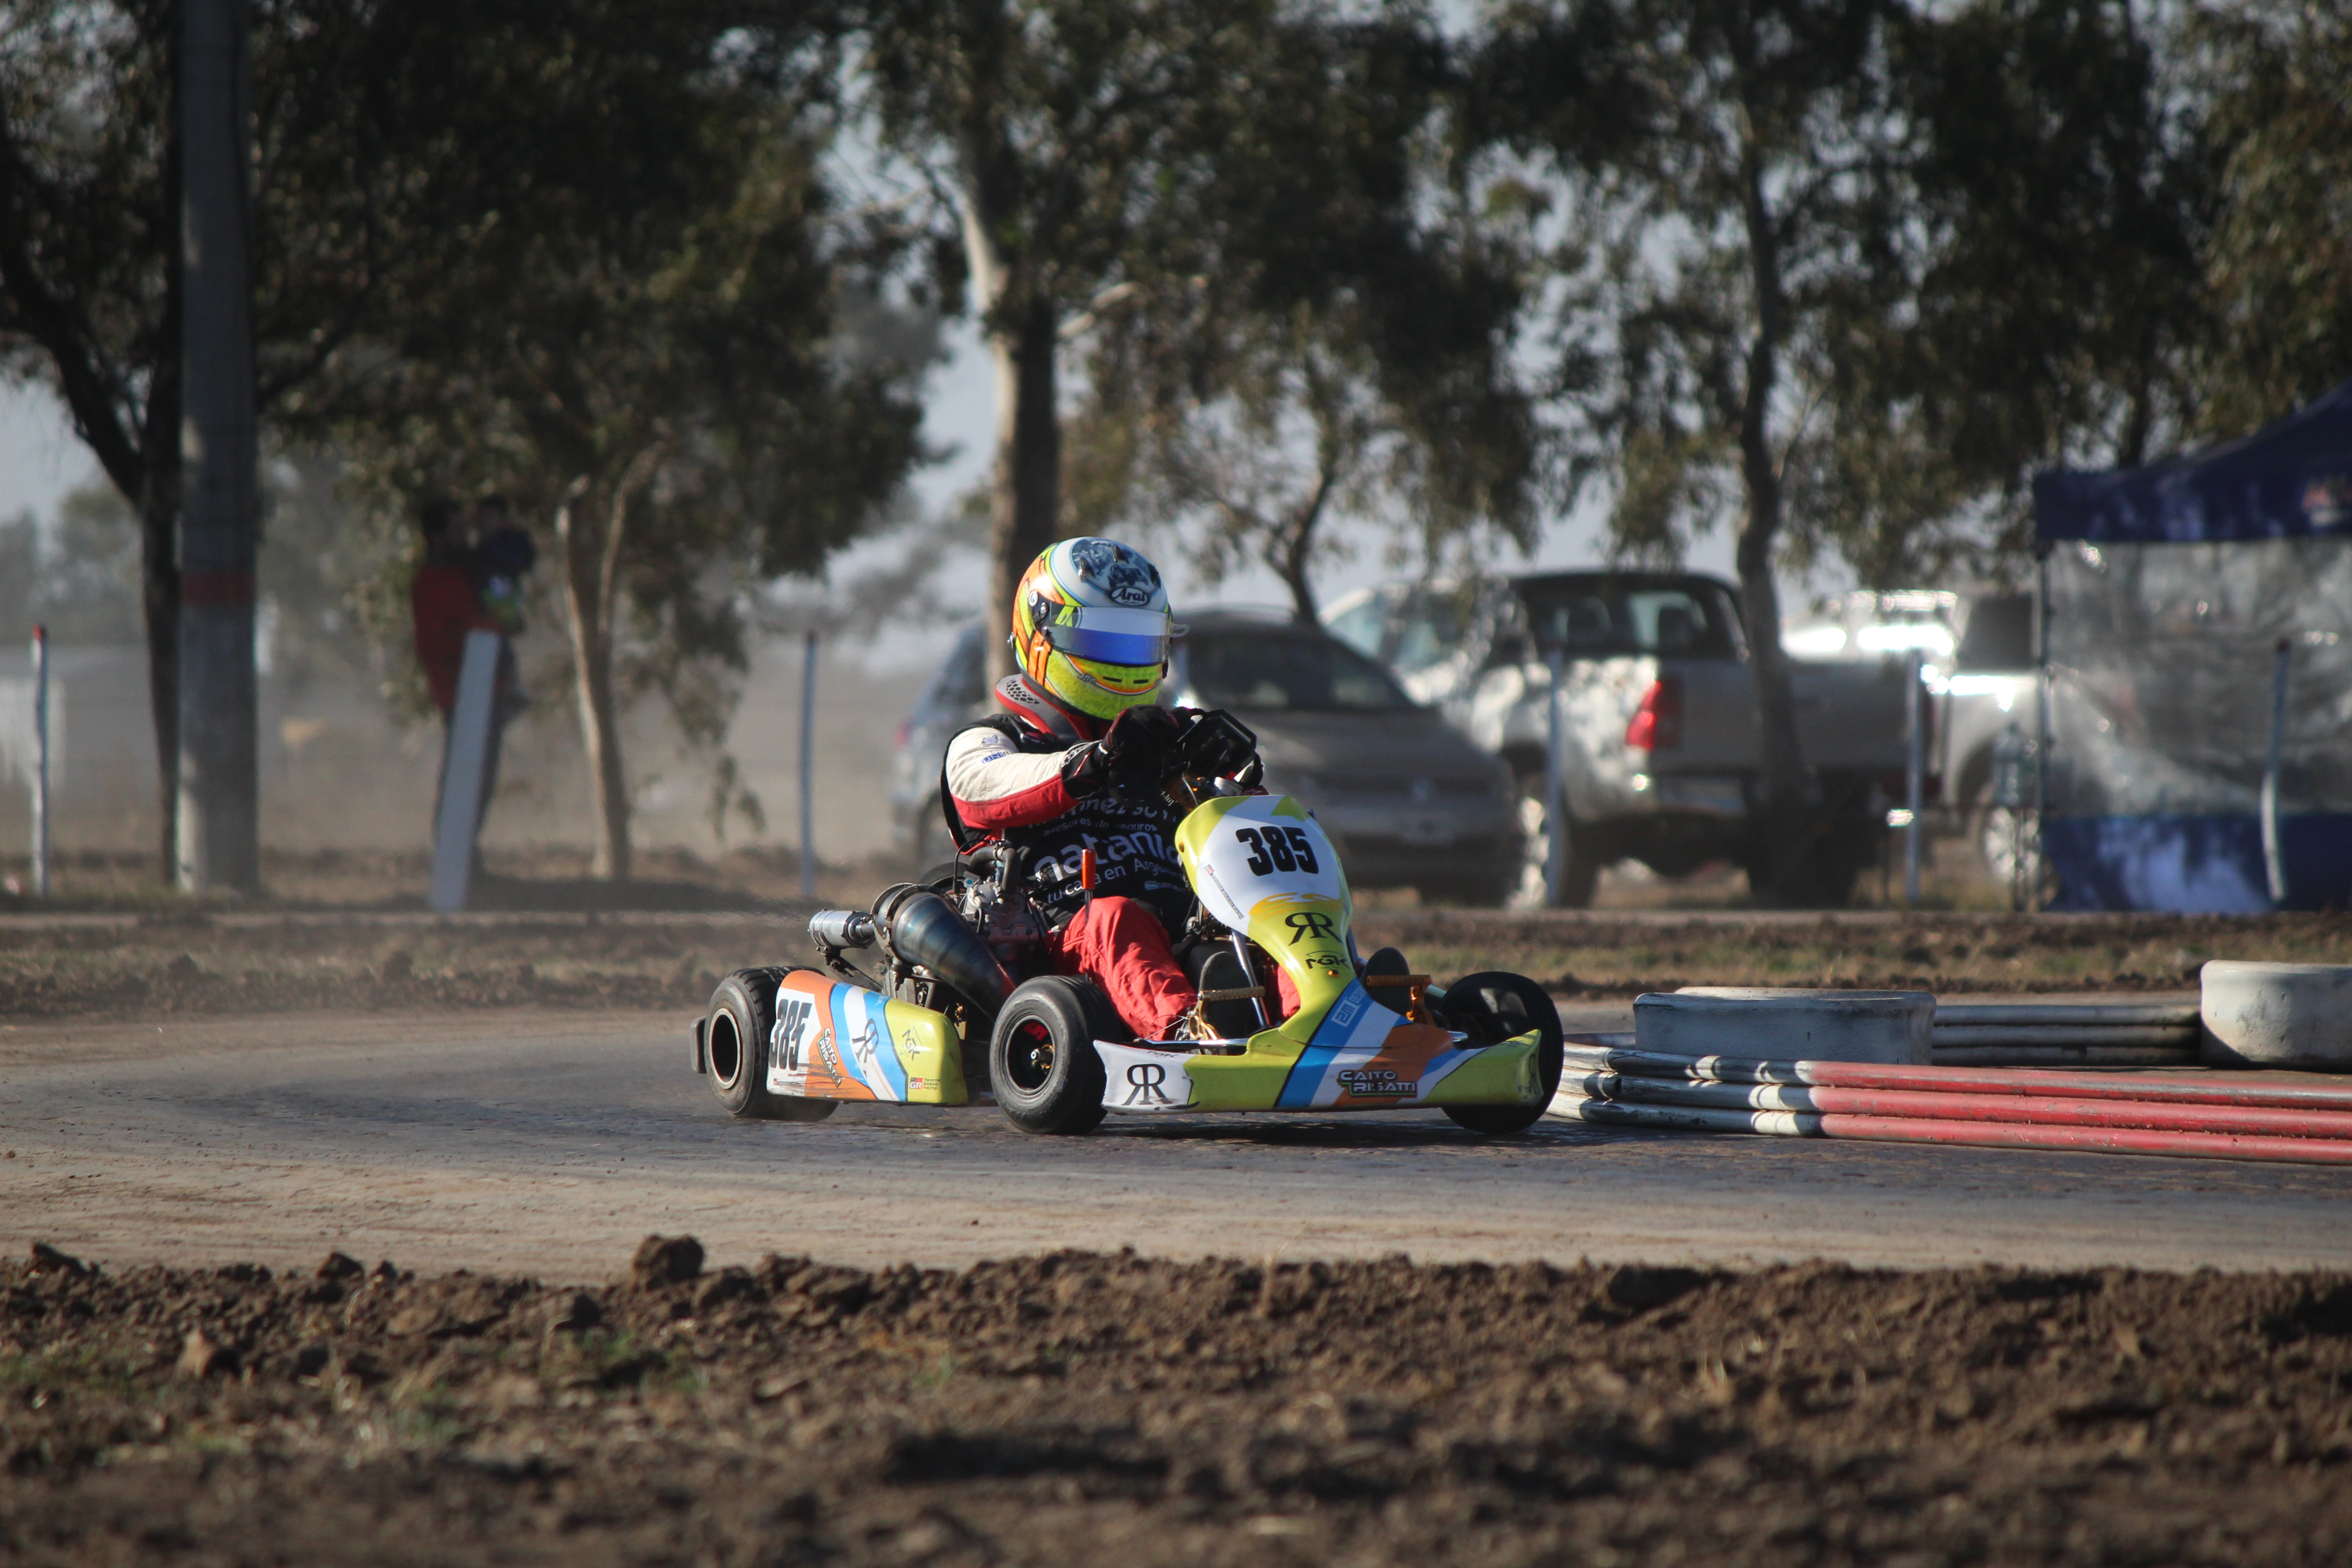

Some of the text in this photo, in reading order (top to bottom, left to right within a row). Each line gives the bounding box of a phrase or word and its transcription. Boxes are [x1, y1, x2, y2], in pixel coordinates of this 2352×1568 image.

[1112, 588, 1146, 602] Arai
[1235, 826, 1319, 877] 385
[1048, 889, 1063, 904] tu
[1065, 874, 1102, 896] caa
[1104, 865, 1127, 880] en
[769, 998, 813, 1071] 385
[824, 1027, 838, 1064] CAITO
[1340, 1071, 1397, 1081] CAITO
